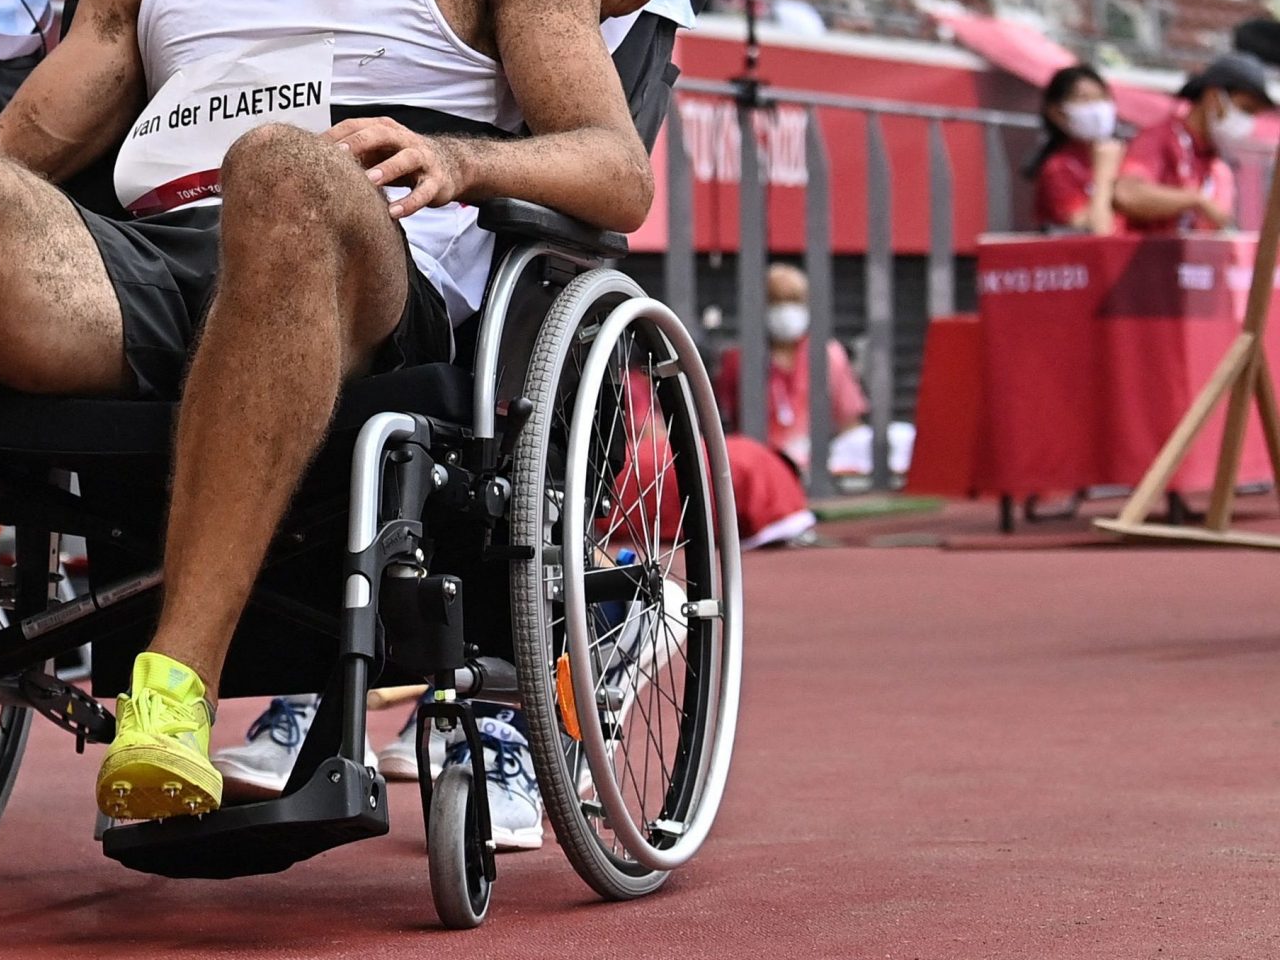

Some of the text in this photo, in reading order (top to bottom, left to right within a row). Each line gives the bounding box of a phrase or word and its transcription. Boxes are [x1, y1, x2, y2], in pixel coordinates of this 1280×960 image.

[131, 81, 322, 139] van der PLAETSEN
